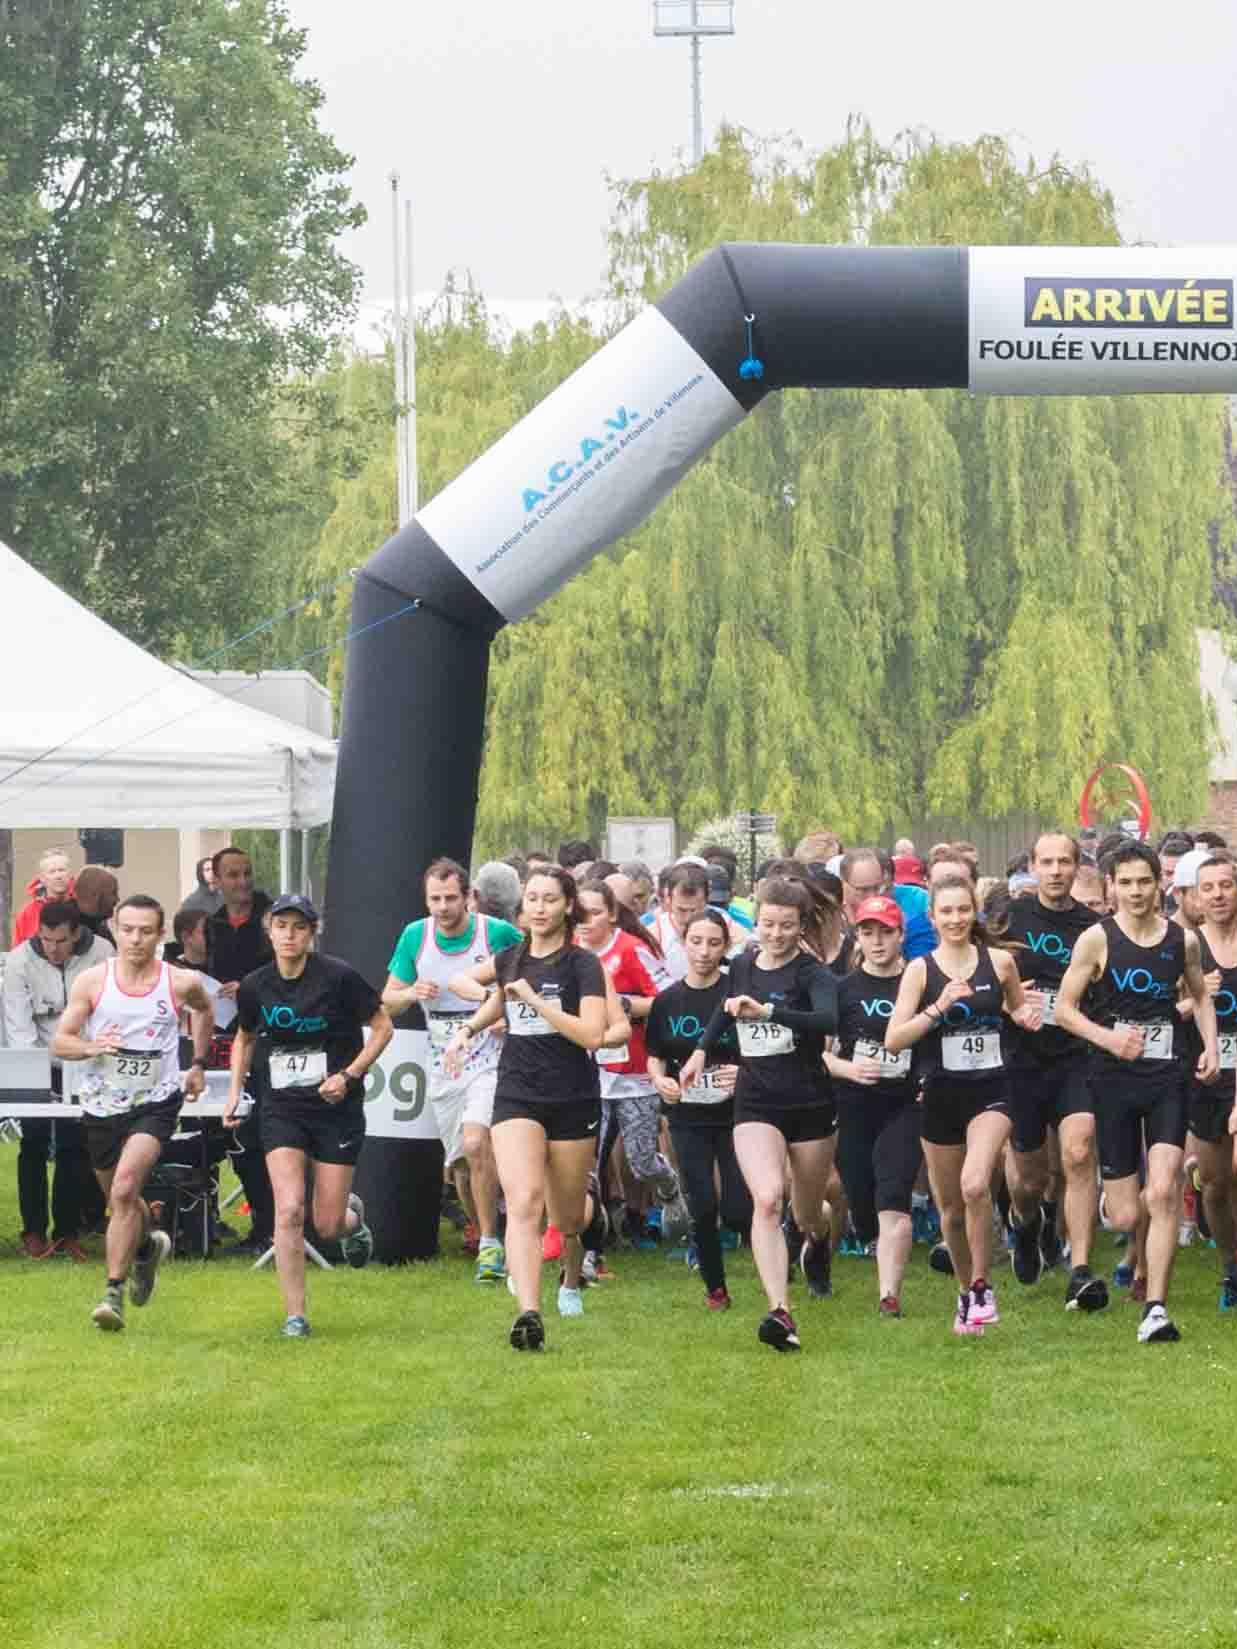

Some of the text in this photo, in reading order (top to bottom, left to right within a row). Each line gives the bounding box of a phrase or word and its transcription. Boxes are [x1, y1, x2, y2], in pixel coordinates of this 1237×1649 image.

[1031, 280, 1228, 322] ARRIVÉE
[979, 333, 1083, 360] FOULÉE
[520, 406, 640, 512] A.C.A.V.
[475, 530, 522, 573] Association
[619, 417, 656, 448] Artisans
[156, 999, 168, 1016] S
[749, 1024, 781, 1039] 216
[962, 1036, 985, 1053] 49
[117, 1059, 151, 1076] 232
[287, 1055, 308, 1073] 47
